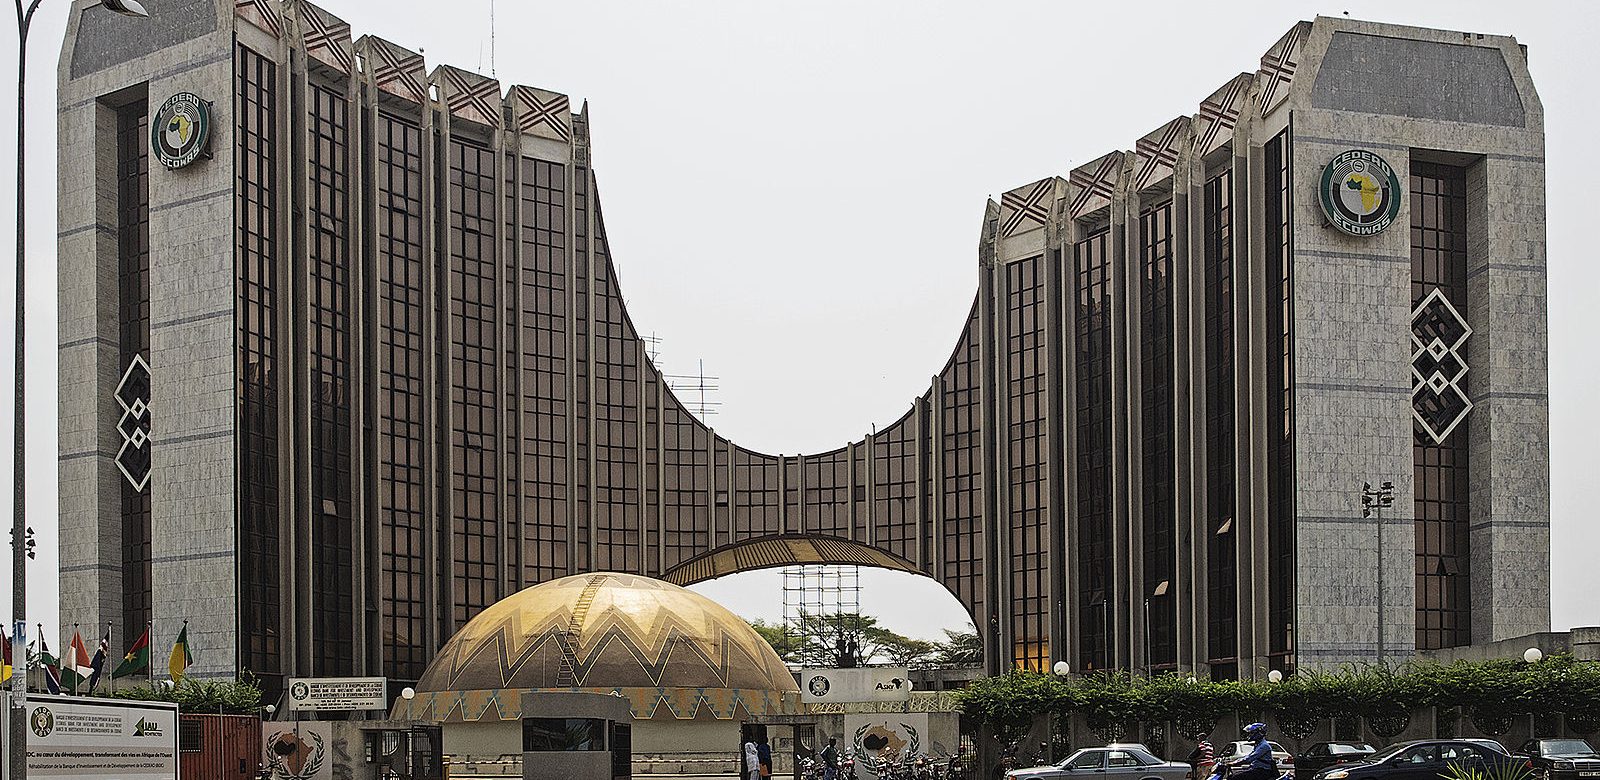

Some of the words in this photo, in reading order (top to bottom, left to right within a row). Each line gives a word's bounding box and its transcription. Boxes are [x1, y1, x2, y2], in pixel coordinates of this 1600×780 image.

[159, 93, 200, 118] CEDEAO
[160, 145, 200, 168] ECOWAS
[1333, 151, 1391, 177] CEDEAO
[1333, 211, 1391, 235] ECOWAS
